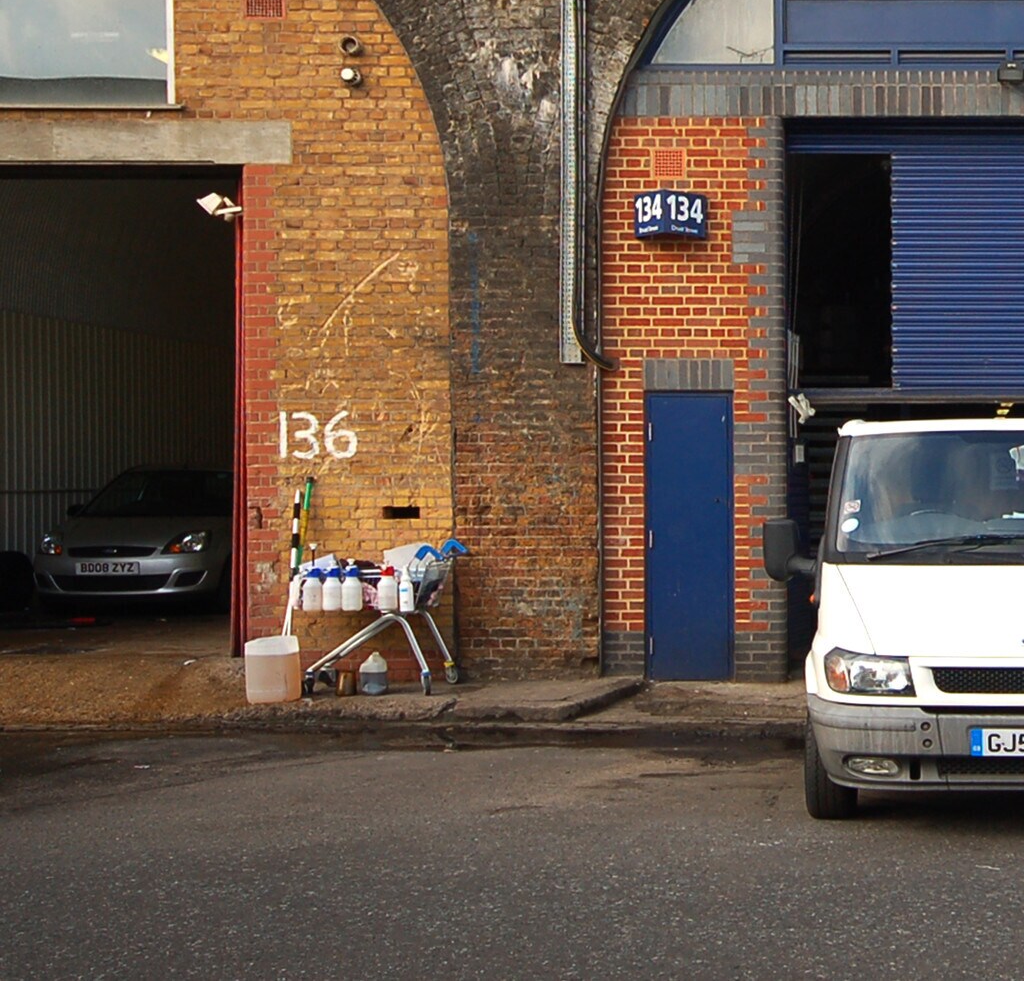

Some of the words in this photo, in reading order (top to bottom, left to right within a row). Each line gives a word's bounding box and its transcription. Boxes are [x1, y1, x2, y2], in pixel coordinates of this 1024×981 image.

[635, 193, 662, 223] 134
[666, 194, 703, 224] 134
[278, 410, 358, 459] 136
[112, 562, 135, 573] ZYZ
